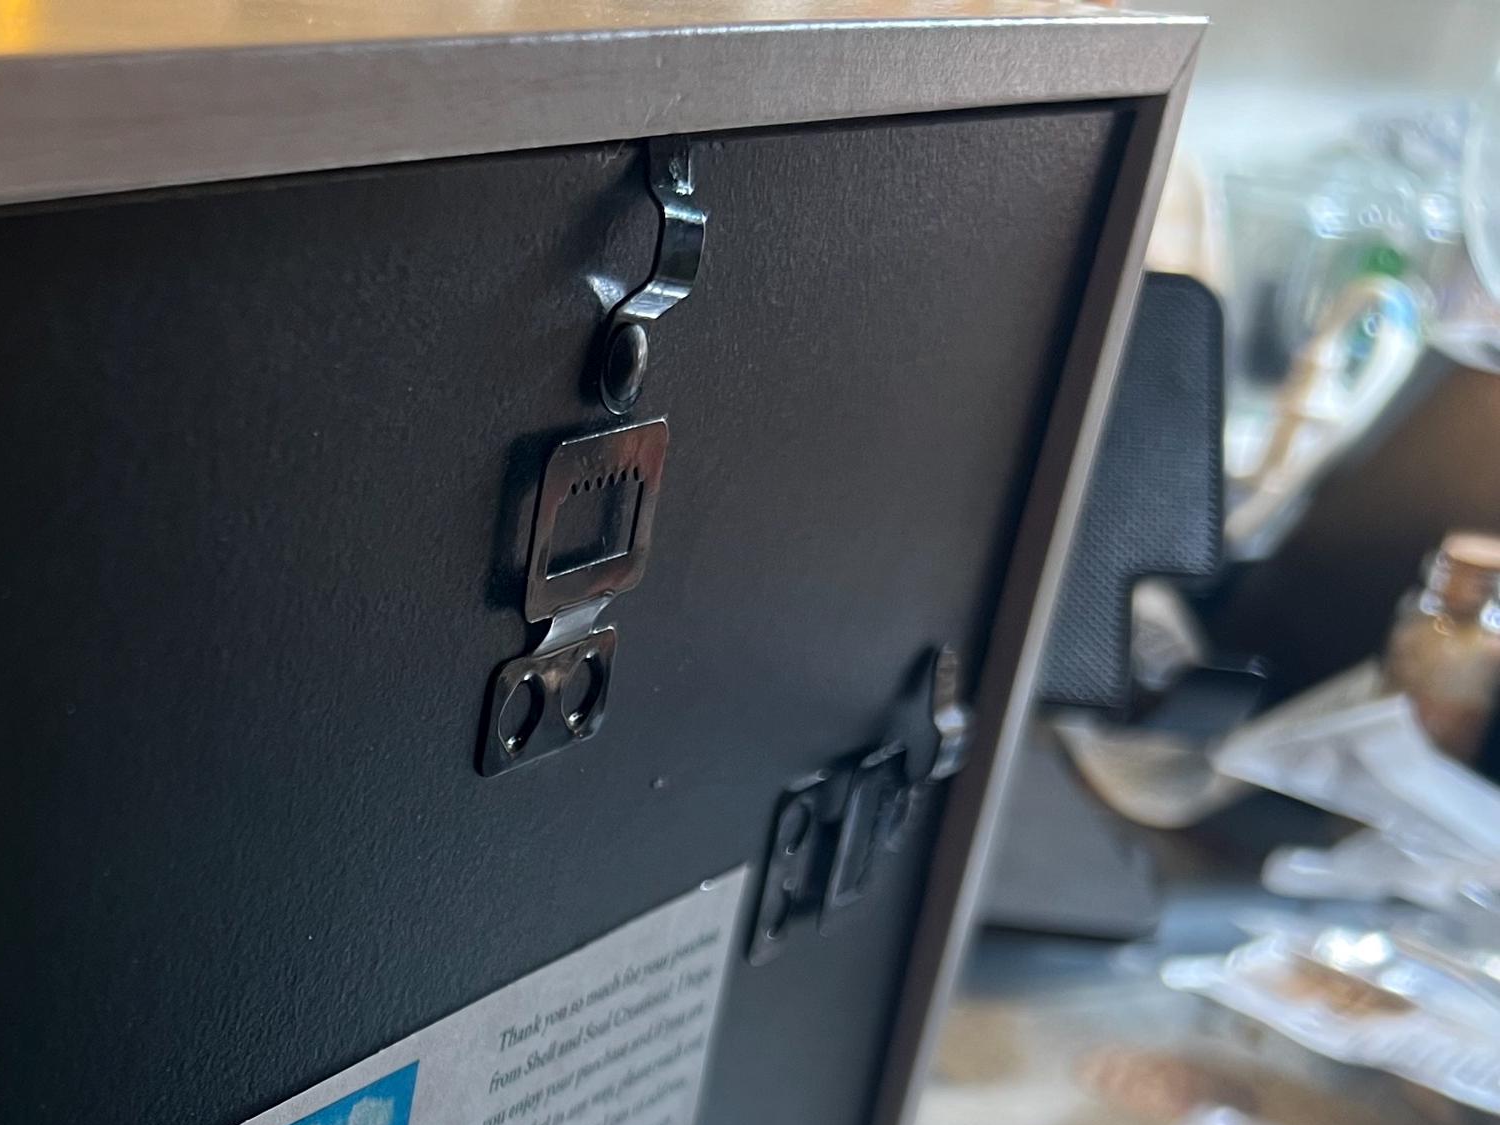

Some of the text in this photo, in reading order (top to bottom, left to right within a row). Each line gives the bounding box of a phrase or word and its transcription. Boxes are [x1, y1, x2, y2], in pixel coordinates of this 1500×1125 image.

[498, 1013, 542, 1052] Thank
[540, 1004, 568, 1037] you
[568, 996, 584, 1016] so
[584, 971, 620, 1007] much
[619, 964, 641, 989] for
[642, 955, 668, 975] your
[487, 1064, 522, 1095] from
[522, 1040, 557, 1076] Shell
[556, 1025, 583, 1058] and
[582, 1009, 613, 1044] Soul
[507, 1088, 544, 1119] enjoy
[542, 1070, 575, 1107] your
[573, 1041, 629, 1089] purchase
[627, 1023, 653, 1054] and
